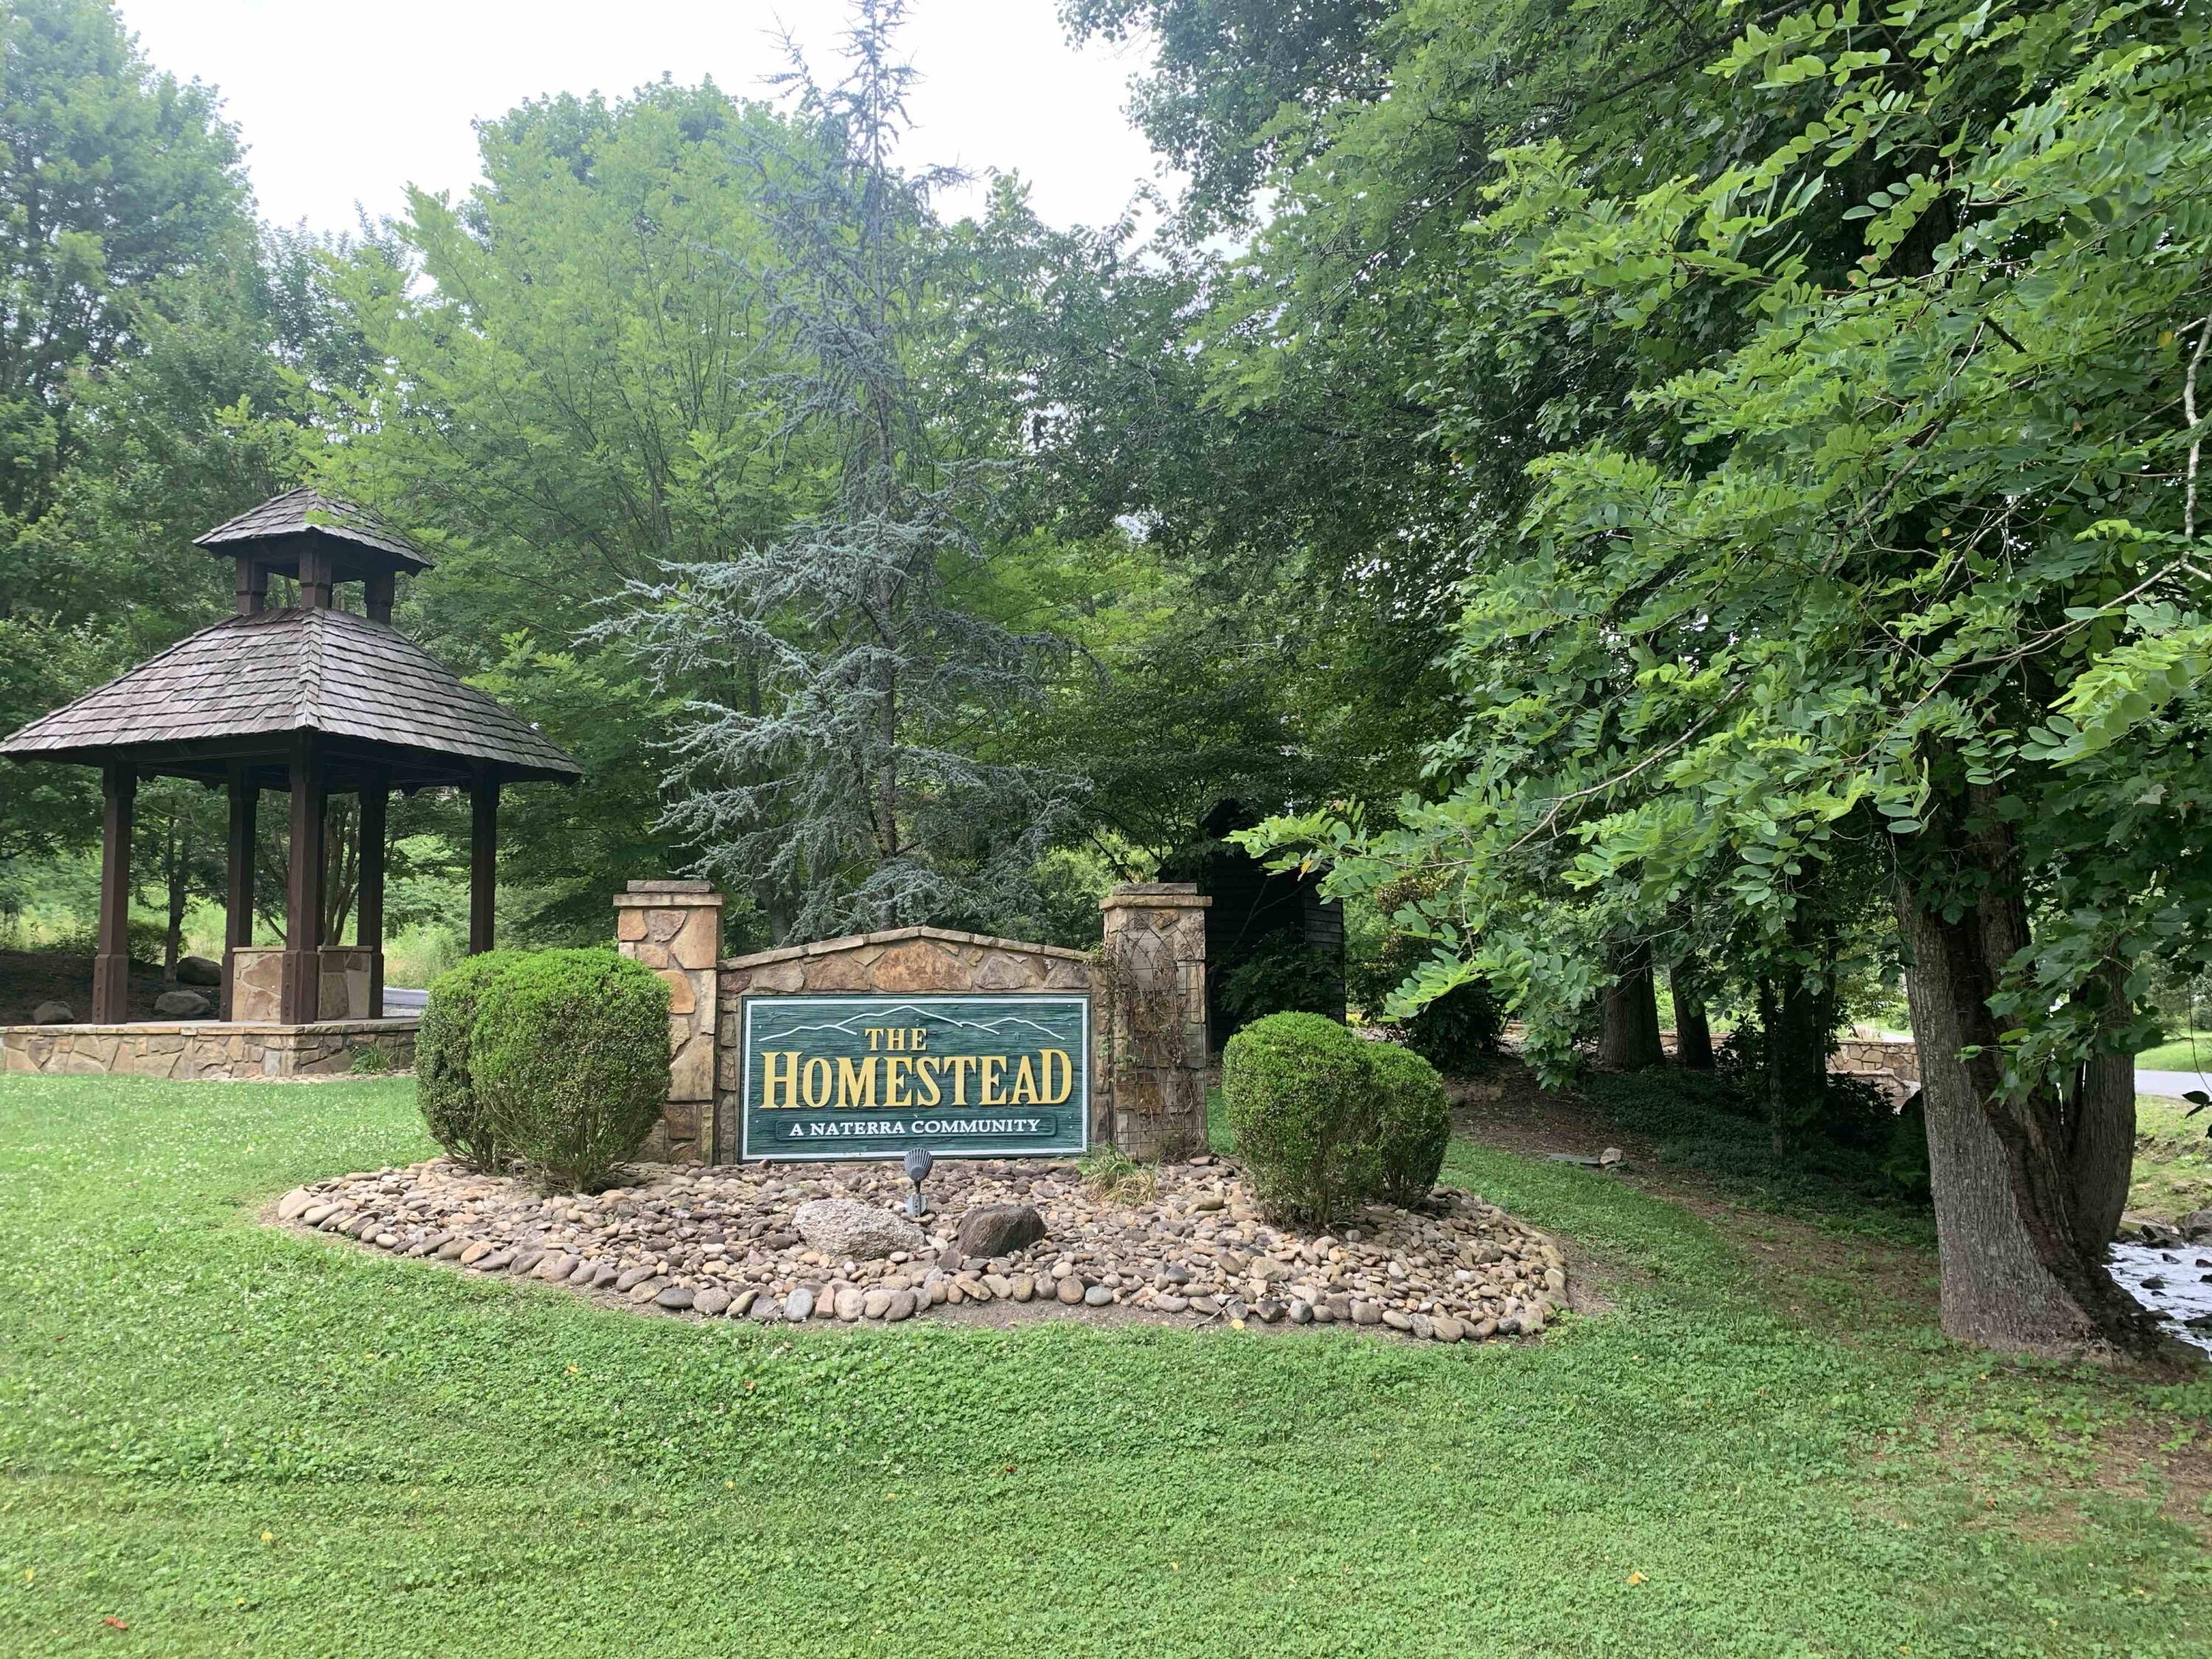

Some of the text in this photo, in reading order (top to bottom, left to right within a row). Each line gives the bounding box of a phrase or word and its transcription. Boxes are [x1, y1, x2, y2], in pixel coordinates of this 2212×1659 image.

[865, 1028, 927, 1051] THE
[759, 1048, 1073, 1109] HOMESTEAD
[789, 1119, 1040, 1136] A NATERRA COMMUNITY
